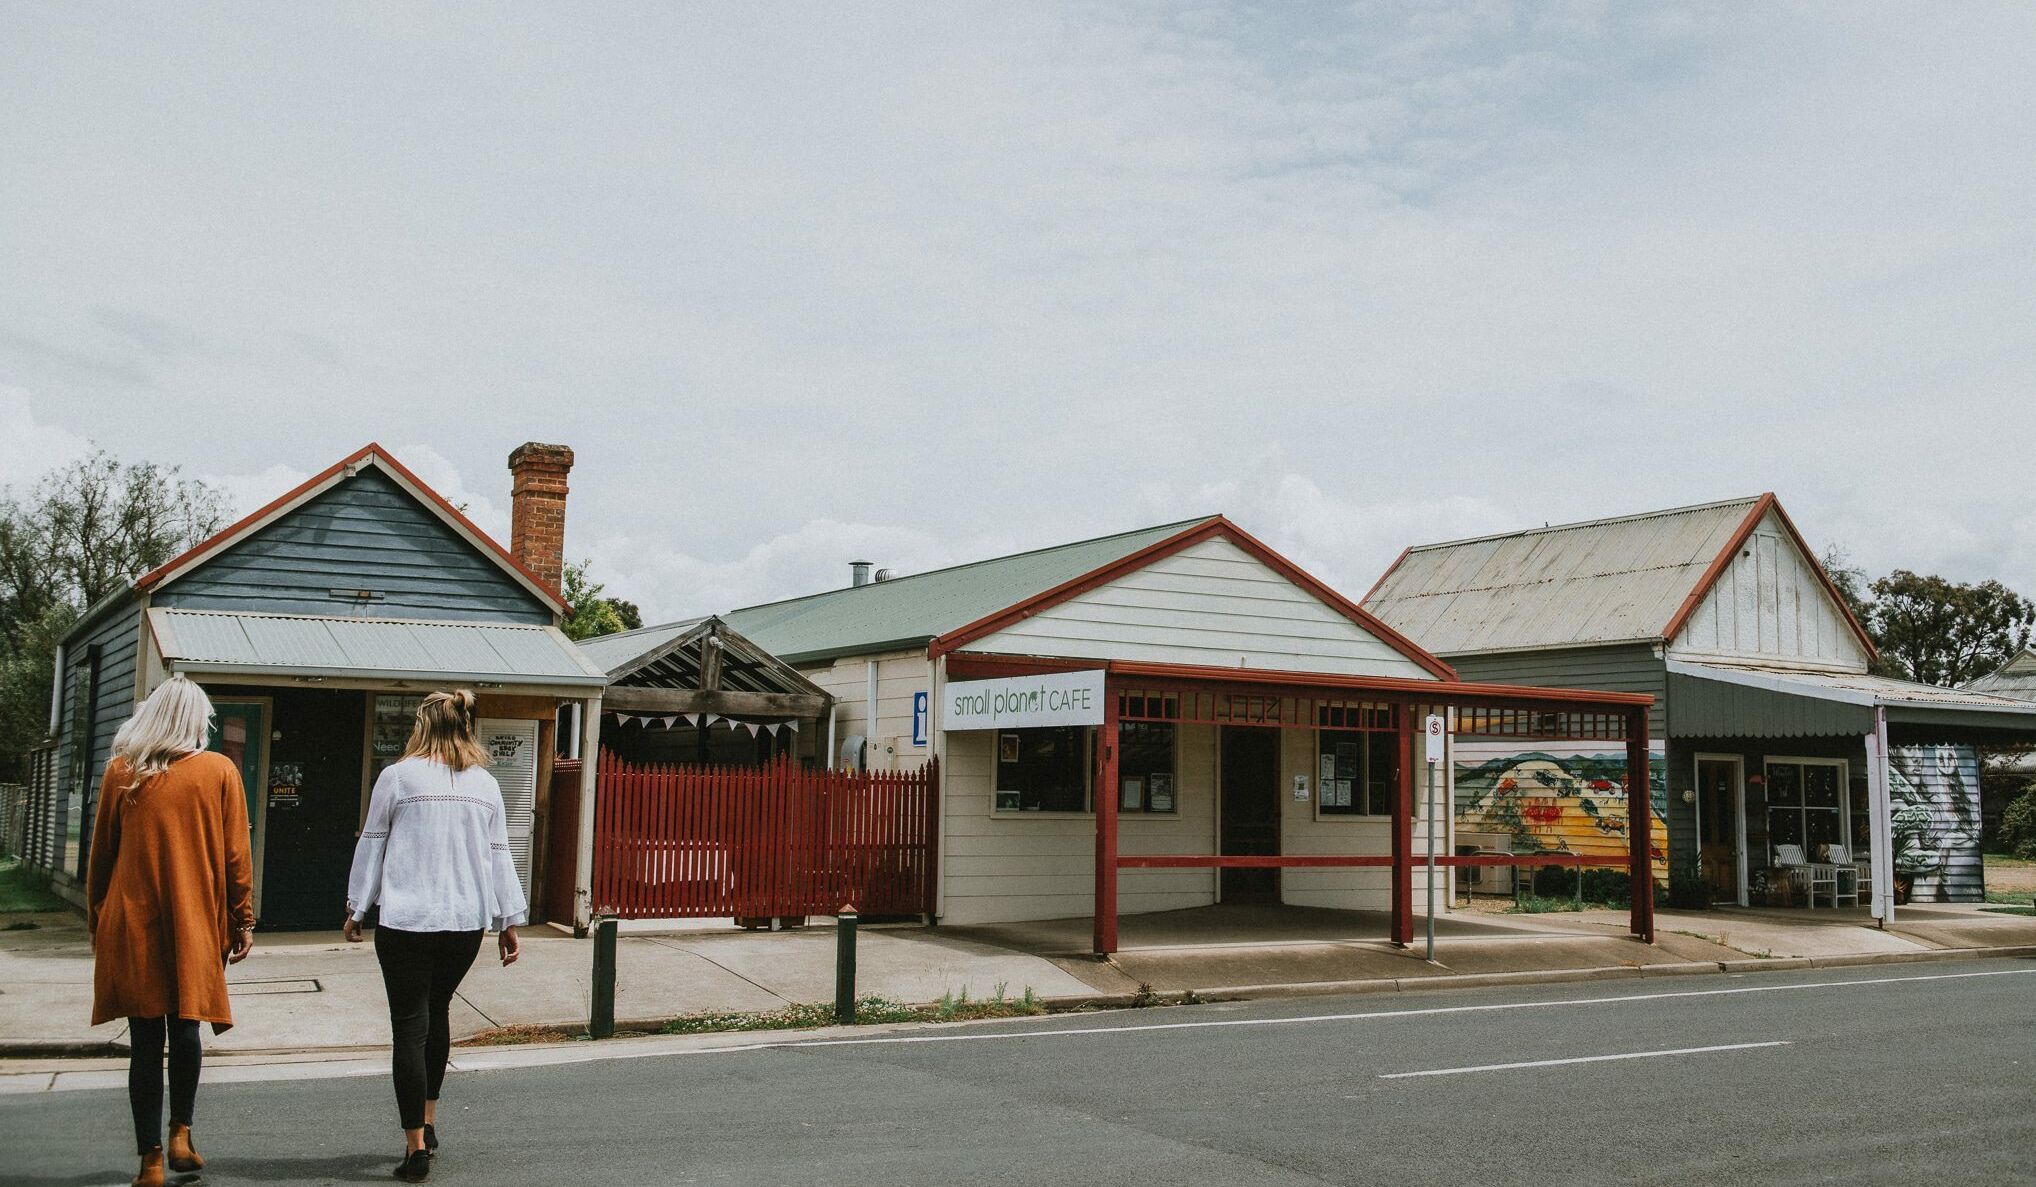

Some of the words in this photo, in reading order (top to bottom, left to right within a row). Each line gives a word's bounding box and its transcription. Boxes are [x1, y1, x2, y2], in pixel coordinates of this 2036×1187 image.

[377, 699, 417, 708] WILDIFE
[954, 688, 990, 716] small
[1049, 688, 1092, 711] CAFE
